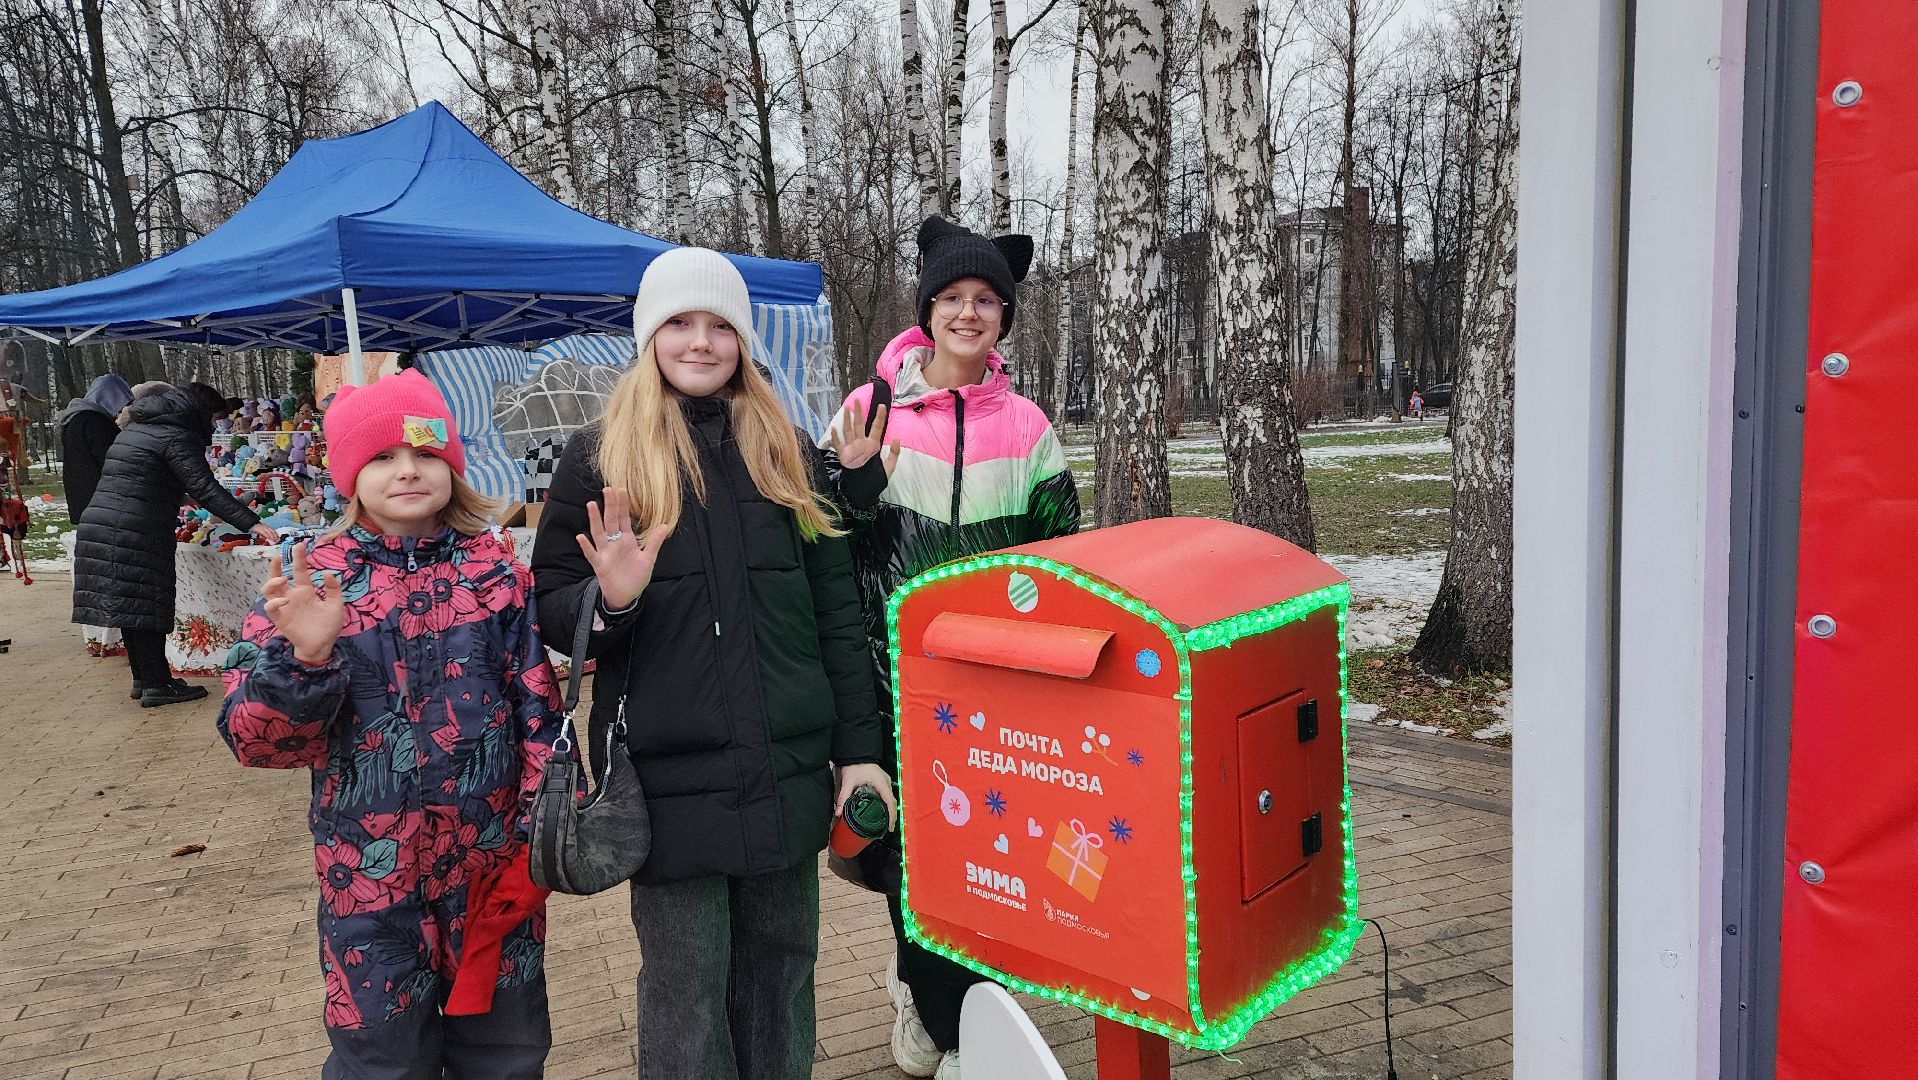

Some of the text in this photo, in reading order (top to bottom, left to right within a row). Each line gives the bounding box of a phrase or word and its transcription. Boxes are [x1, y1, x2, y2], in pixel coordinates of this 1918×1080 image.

[1000, 727, 1064, 758] ПОЧТА
[967, 746, 1104, 796] ДЕДА МОРОЗА
[965, 861, 1027, 899] ЗИМА
[972, 887, 1027, 912] ПОДМОСКОВЬЕ
[1056, 909, 1079, 922] ПАРКИ
[1057, 916, 1110, 940] ПОДМОСКОВЬЯ
